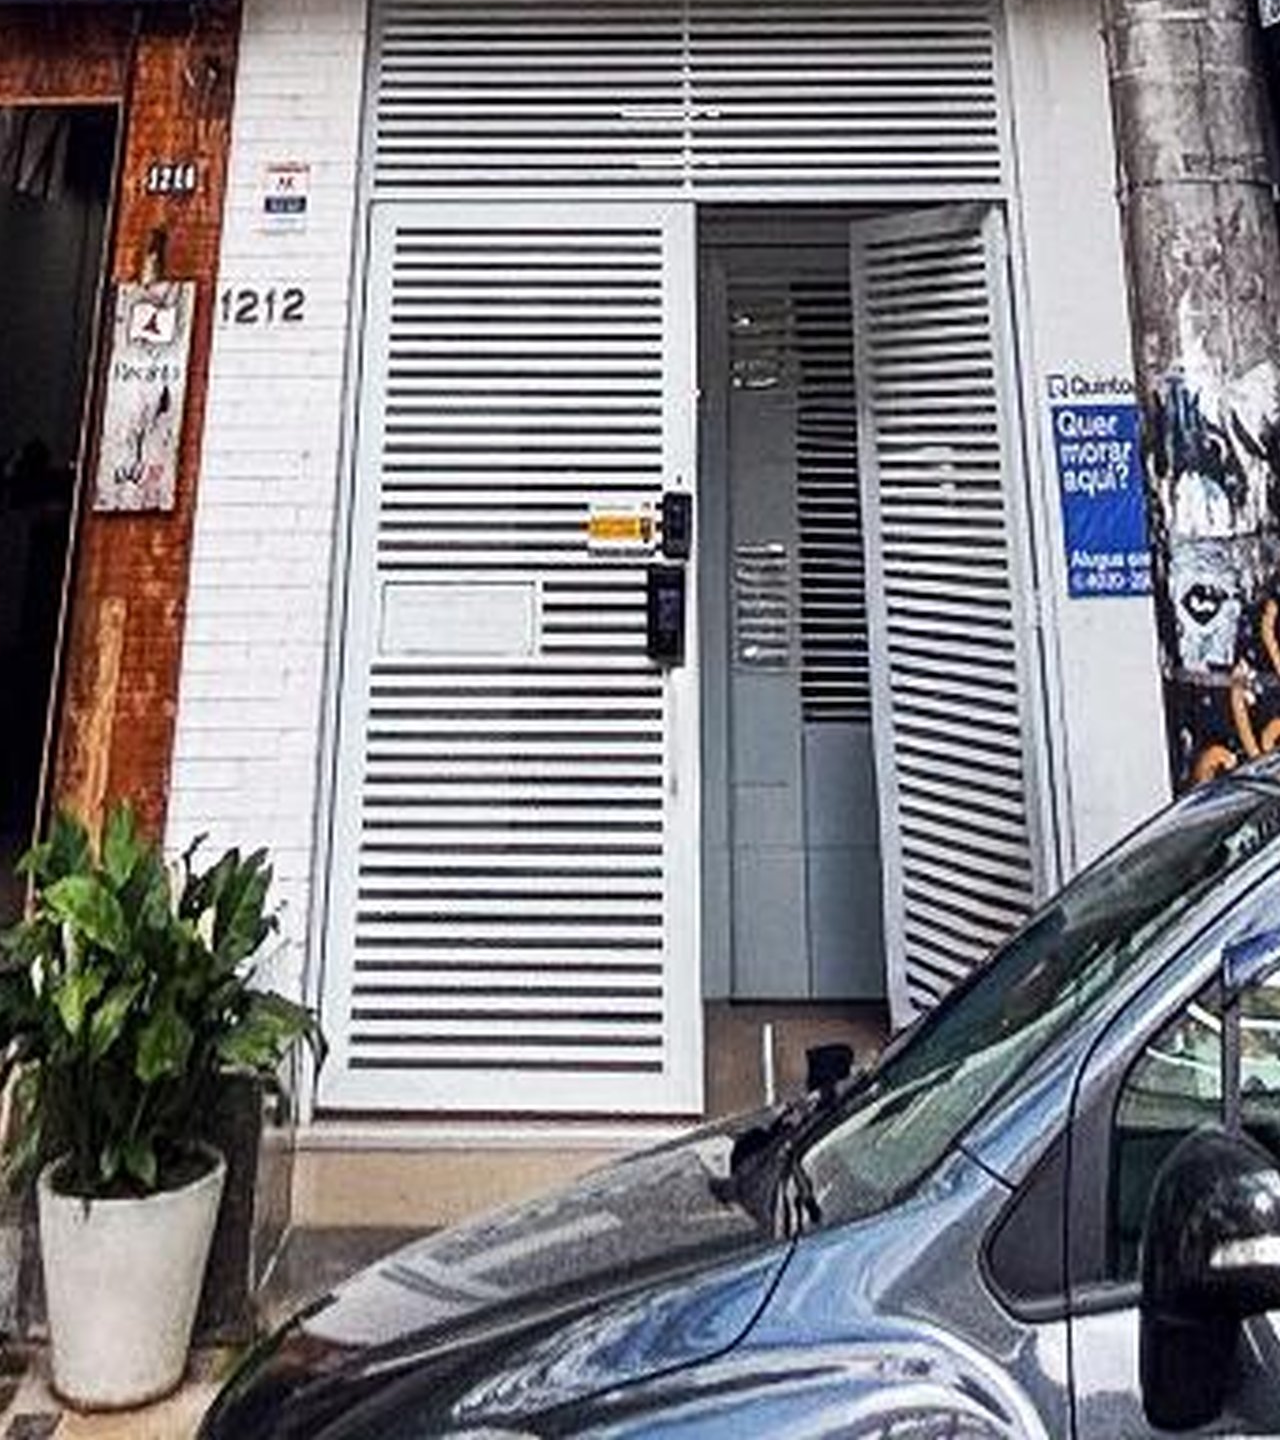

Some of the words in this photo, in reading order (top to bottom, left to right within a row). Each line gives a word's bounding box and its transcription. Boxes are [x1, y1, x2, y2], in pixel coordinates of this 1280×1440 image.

[221, 287, 305, 323] 1212
[1057, 410, 1118, 438] Quer
[1061, 442, 1131, 465] morar
[1063, 463, 1128, 498] aqui?
